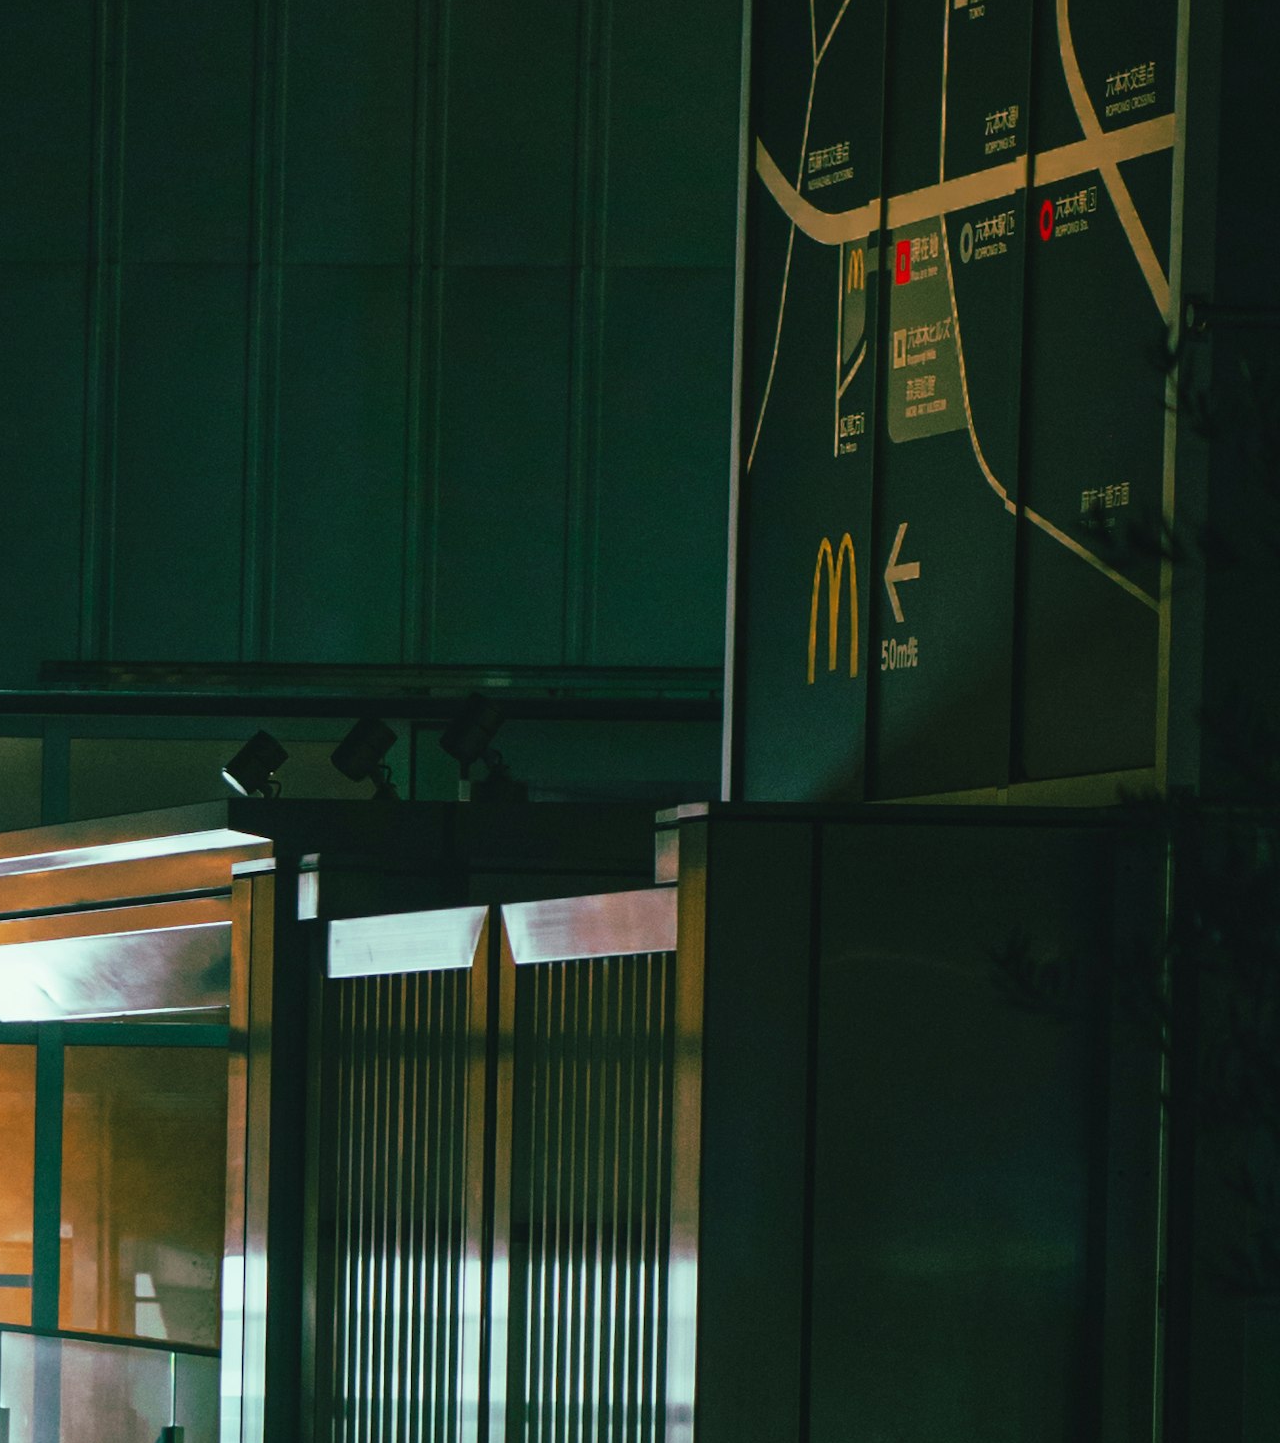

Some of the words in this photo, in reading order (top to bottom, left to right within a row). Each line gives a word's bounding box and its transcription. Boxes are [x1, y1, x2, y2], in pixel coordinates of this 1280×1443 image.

[1106, 61, 1155, 98] 六本木交差点
[910, 232, 939, 263] 現在地
[907, 315, 951, 349] 六本木ヒルズ
